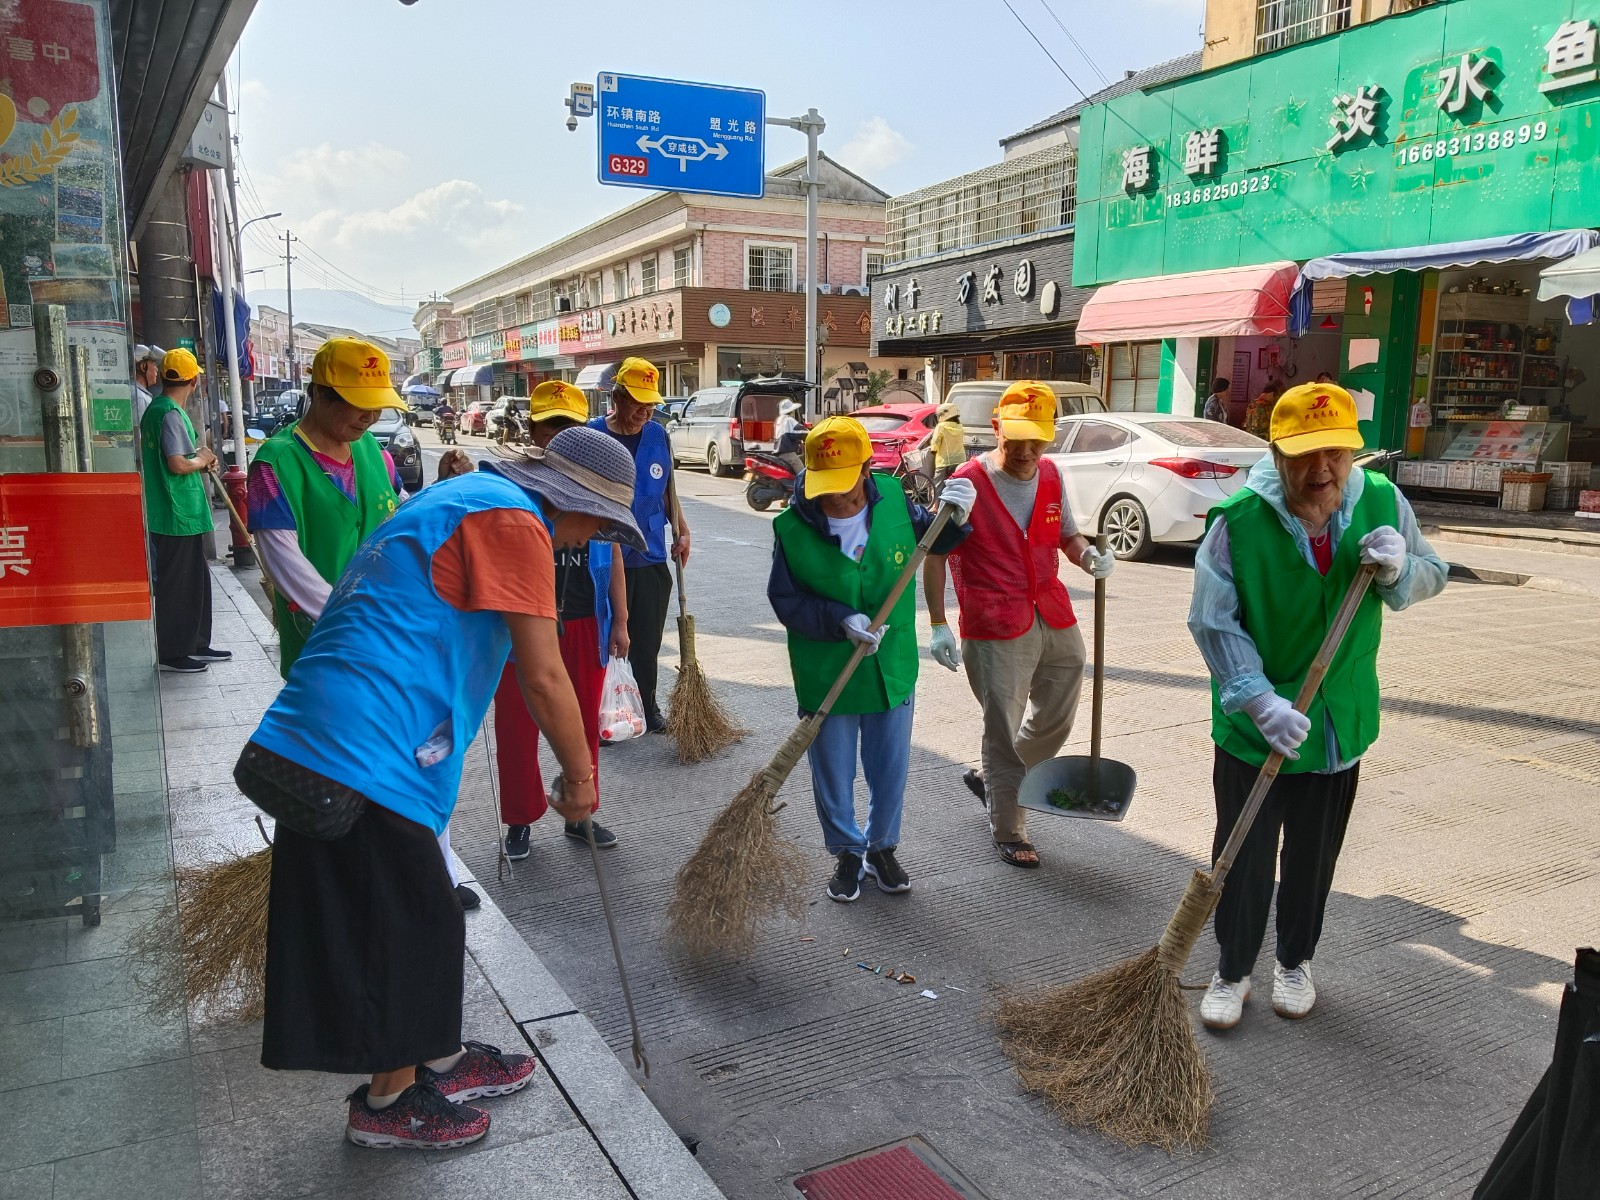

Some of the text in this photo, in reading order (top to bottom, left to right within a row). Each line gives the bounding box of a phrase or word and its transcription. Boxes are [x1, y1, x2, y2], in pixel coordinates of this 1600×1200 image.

[603, 75, 613, 85] 南
[606, 105, 661, 124] 环镇南路
[607, 121, 634, 129] Huanzhen
[709, 117, 756, 134] 盟光路
[712, 132, 743, 142] Mengguang
[1398, 121, 1548, 166] 16683138899
[667, 141, 698, 154] 穿咸线
[611, 157, 646, 175] G329
[1166, 175, 1271, 208] 18368250323
[103, 404, 122, 421] 拉
